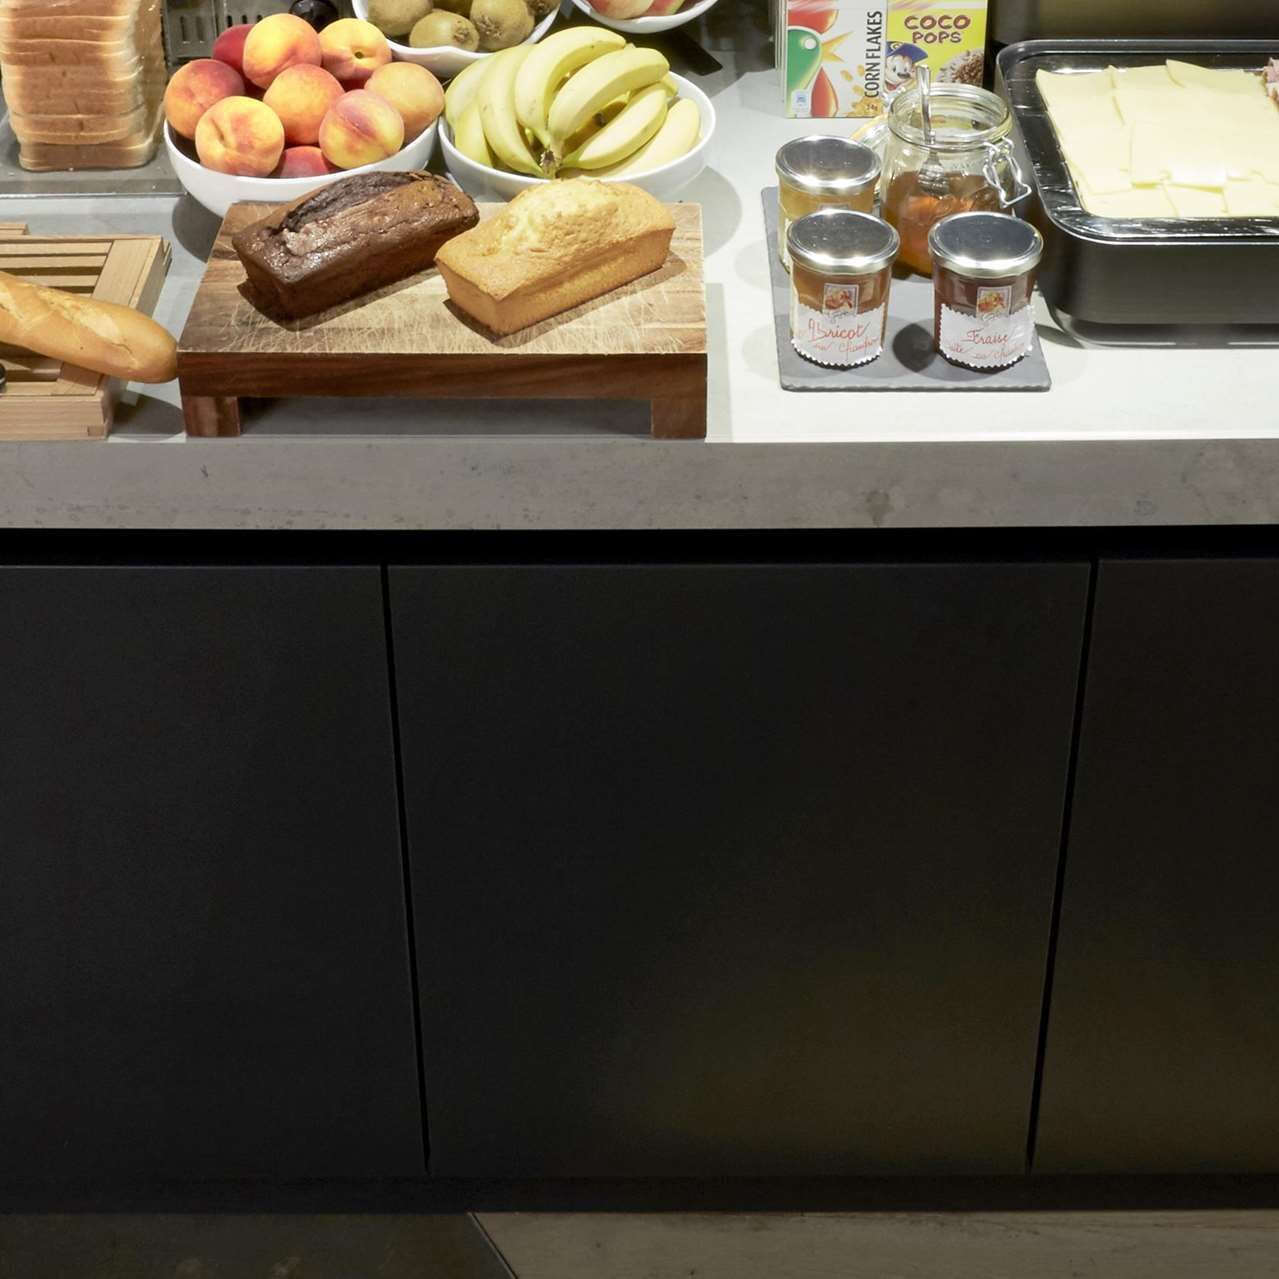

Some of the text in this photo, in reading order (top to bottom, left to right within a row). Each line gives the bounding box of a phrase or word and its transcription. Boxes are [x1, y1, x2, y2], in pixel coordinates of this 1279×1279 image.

[904, 14, 971, 30] COCO
[912, 31, 963, 45] POPS
[864, 10, 883, 98] CORN FLAKES
[808, 318, 868, 342] Abricot
[961, 327, 1009, 345] Fraise
